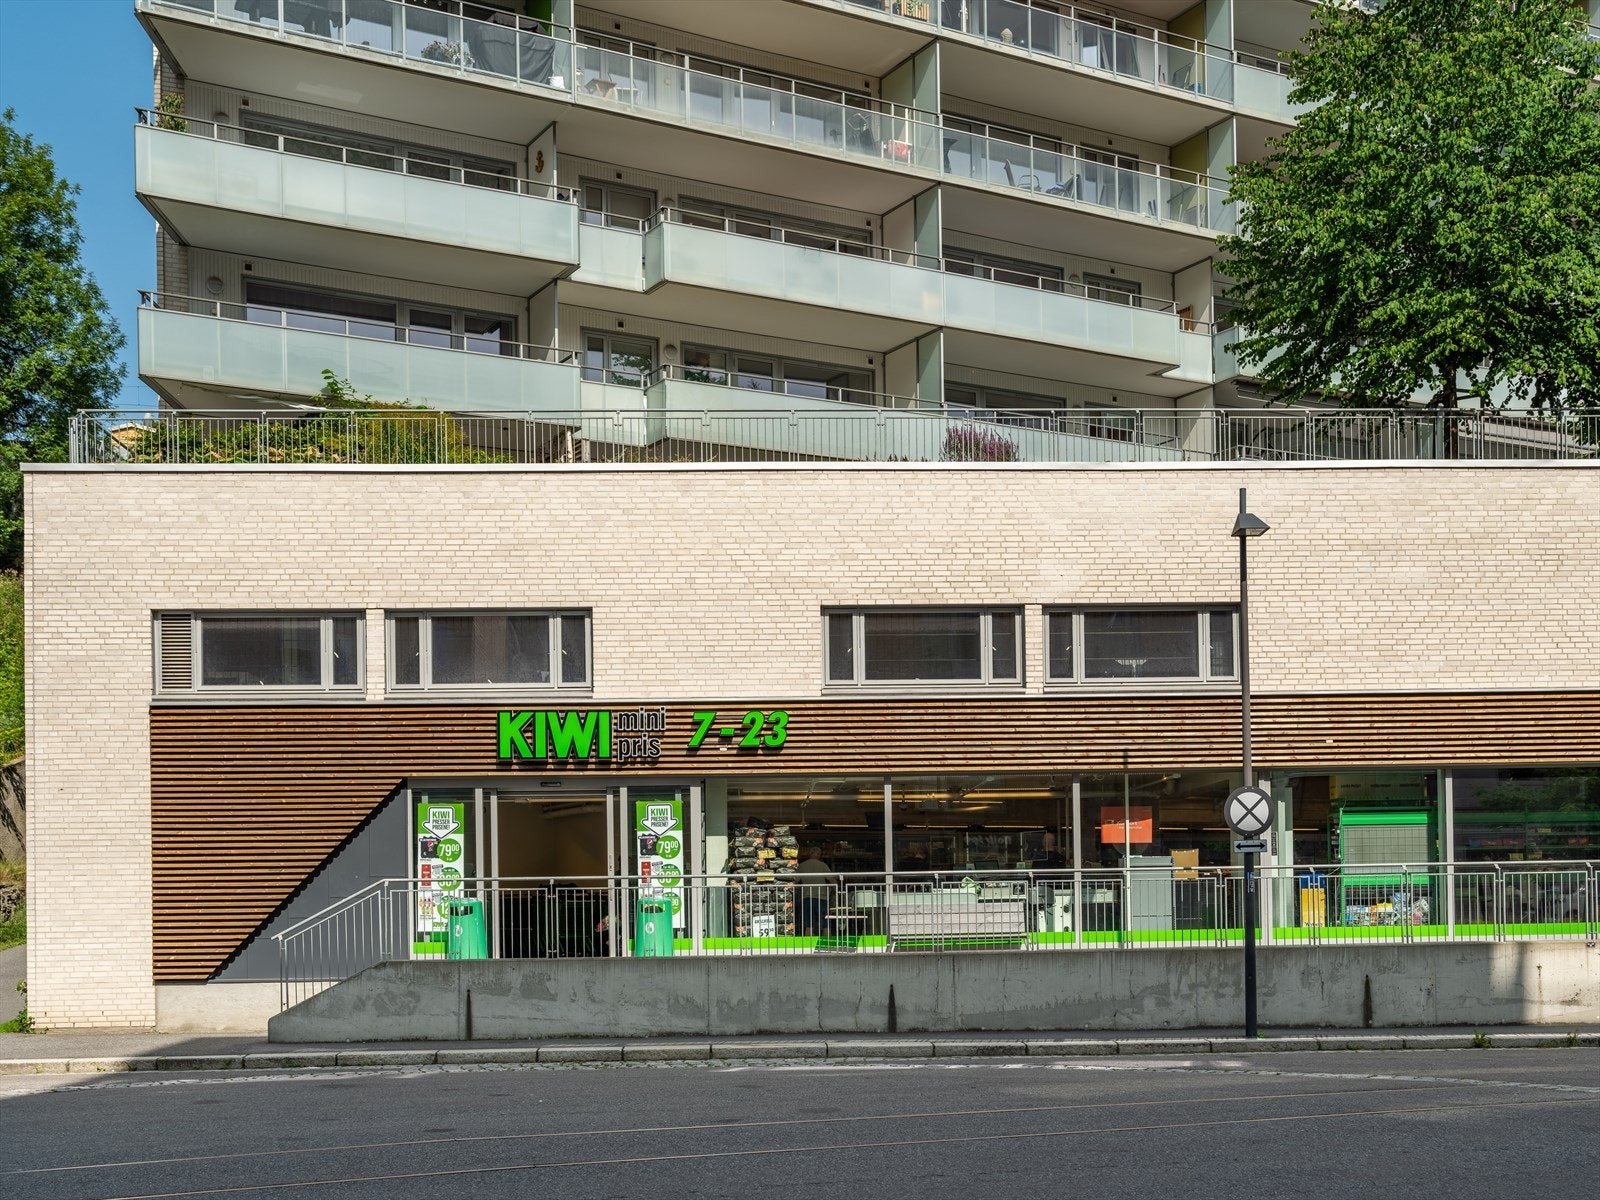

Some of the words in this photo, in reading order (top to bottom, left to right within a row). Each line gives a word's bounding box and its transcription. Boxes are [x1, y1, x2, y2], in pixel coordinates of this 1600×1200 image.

[618, 706, 666, 730] mini
[498, 710, 613, 759] KIWI
[618, 733, 661, 762] pris
[650, 808, 669, 816] KIWI
